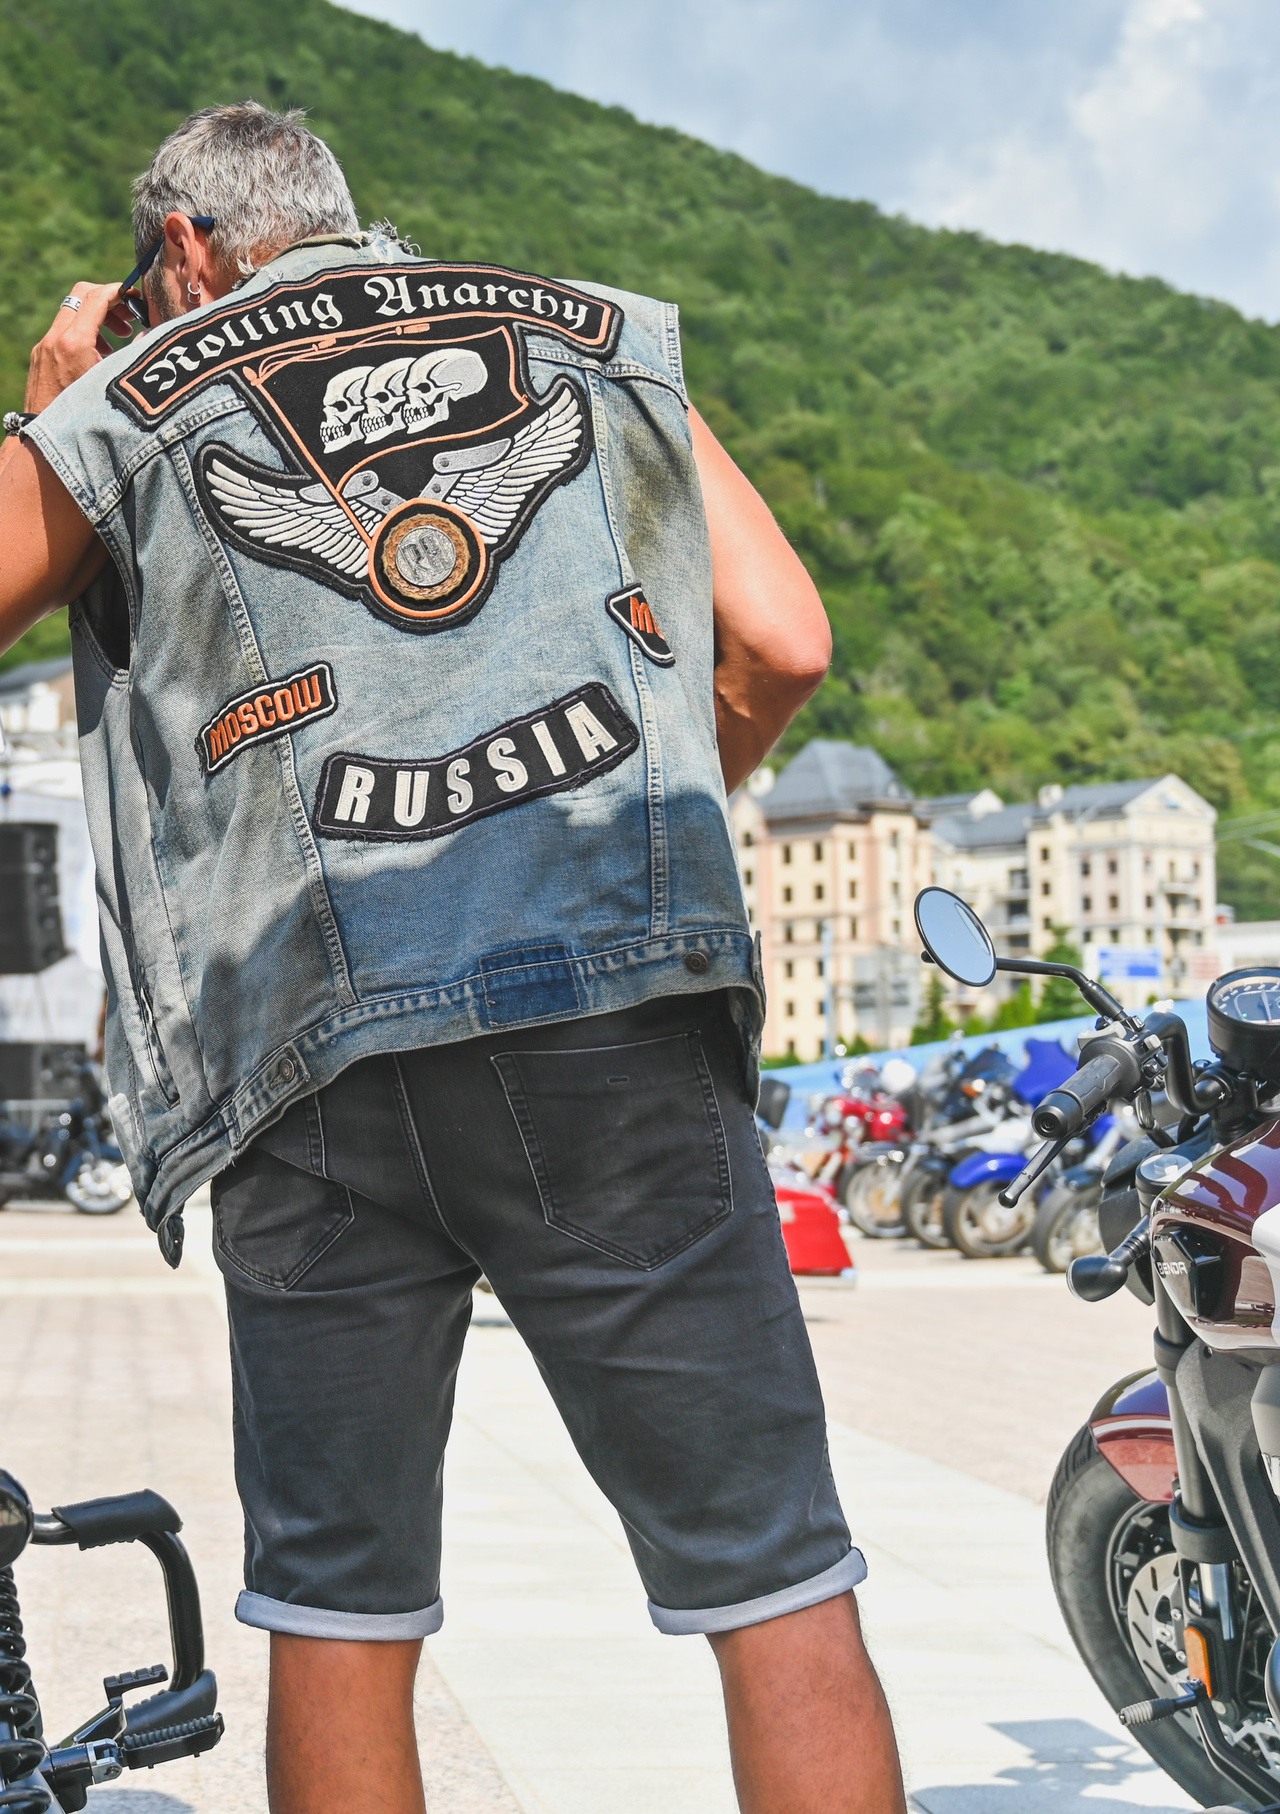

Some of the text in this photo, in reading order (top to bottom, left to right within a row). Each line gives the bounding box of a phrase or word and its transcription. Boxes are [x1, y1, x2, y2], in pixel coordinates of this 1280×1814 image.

[143, 275, 589, 393] Rolling Anarchy
[209, 675, 322, 761] MOSCOW
[334, 701, 619, 827] RUSSIA
[1156, 1261, 1187, 1275] BENDA
